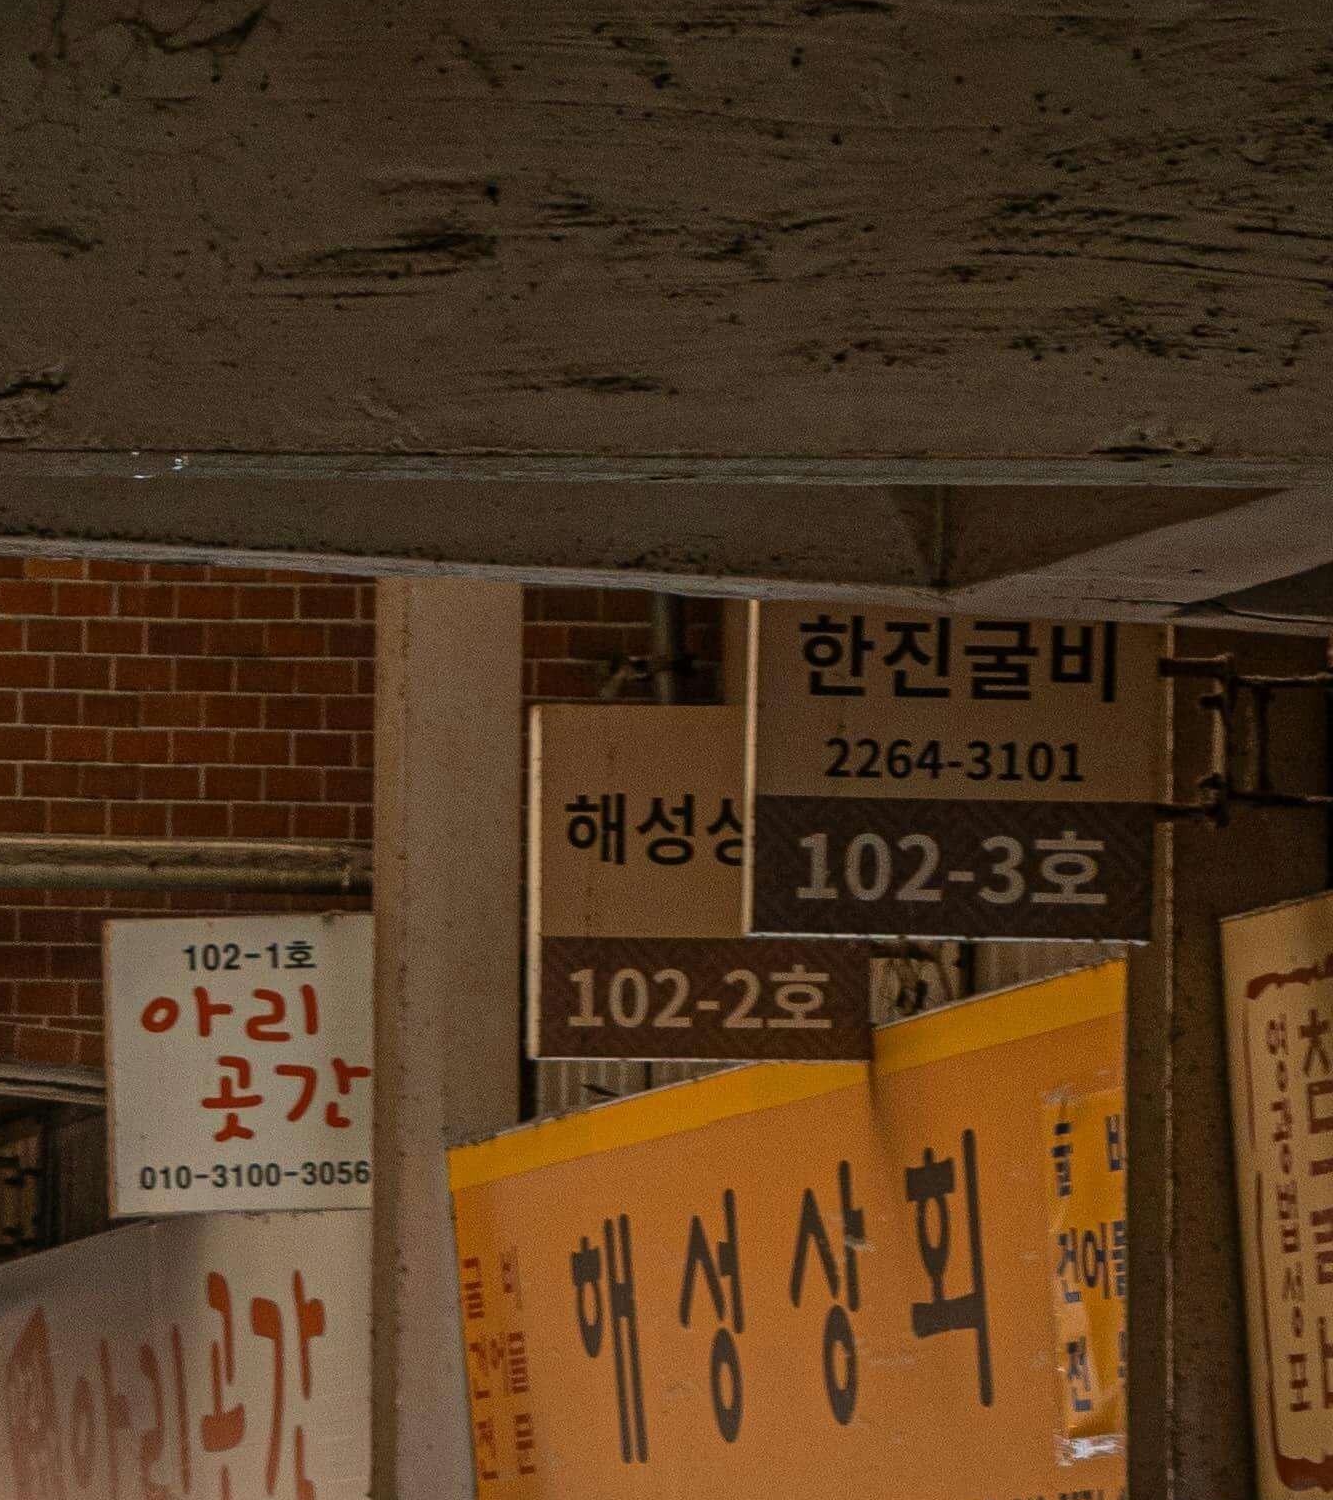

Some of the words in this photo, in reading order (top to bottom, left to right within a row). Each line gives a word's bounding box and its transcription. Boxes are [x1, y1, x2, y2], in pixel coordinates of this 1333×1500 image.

[799, 614, 1118, 702] 한진굴비
[824, 736, 1085, 783] 2264-3101
[795, 830, 1108, 906] 102-3호
[182, 941, 317, 972] 102-1호
[140, 983, 320, 1044] 아리
[566, 965, 834, 1031] 102-2호
[139, 1160, 372, 1192] 010-3100-3056
[568, 1128, 995, 1465] 해성상회
